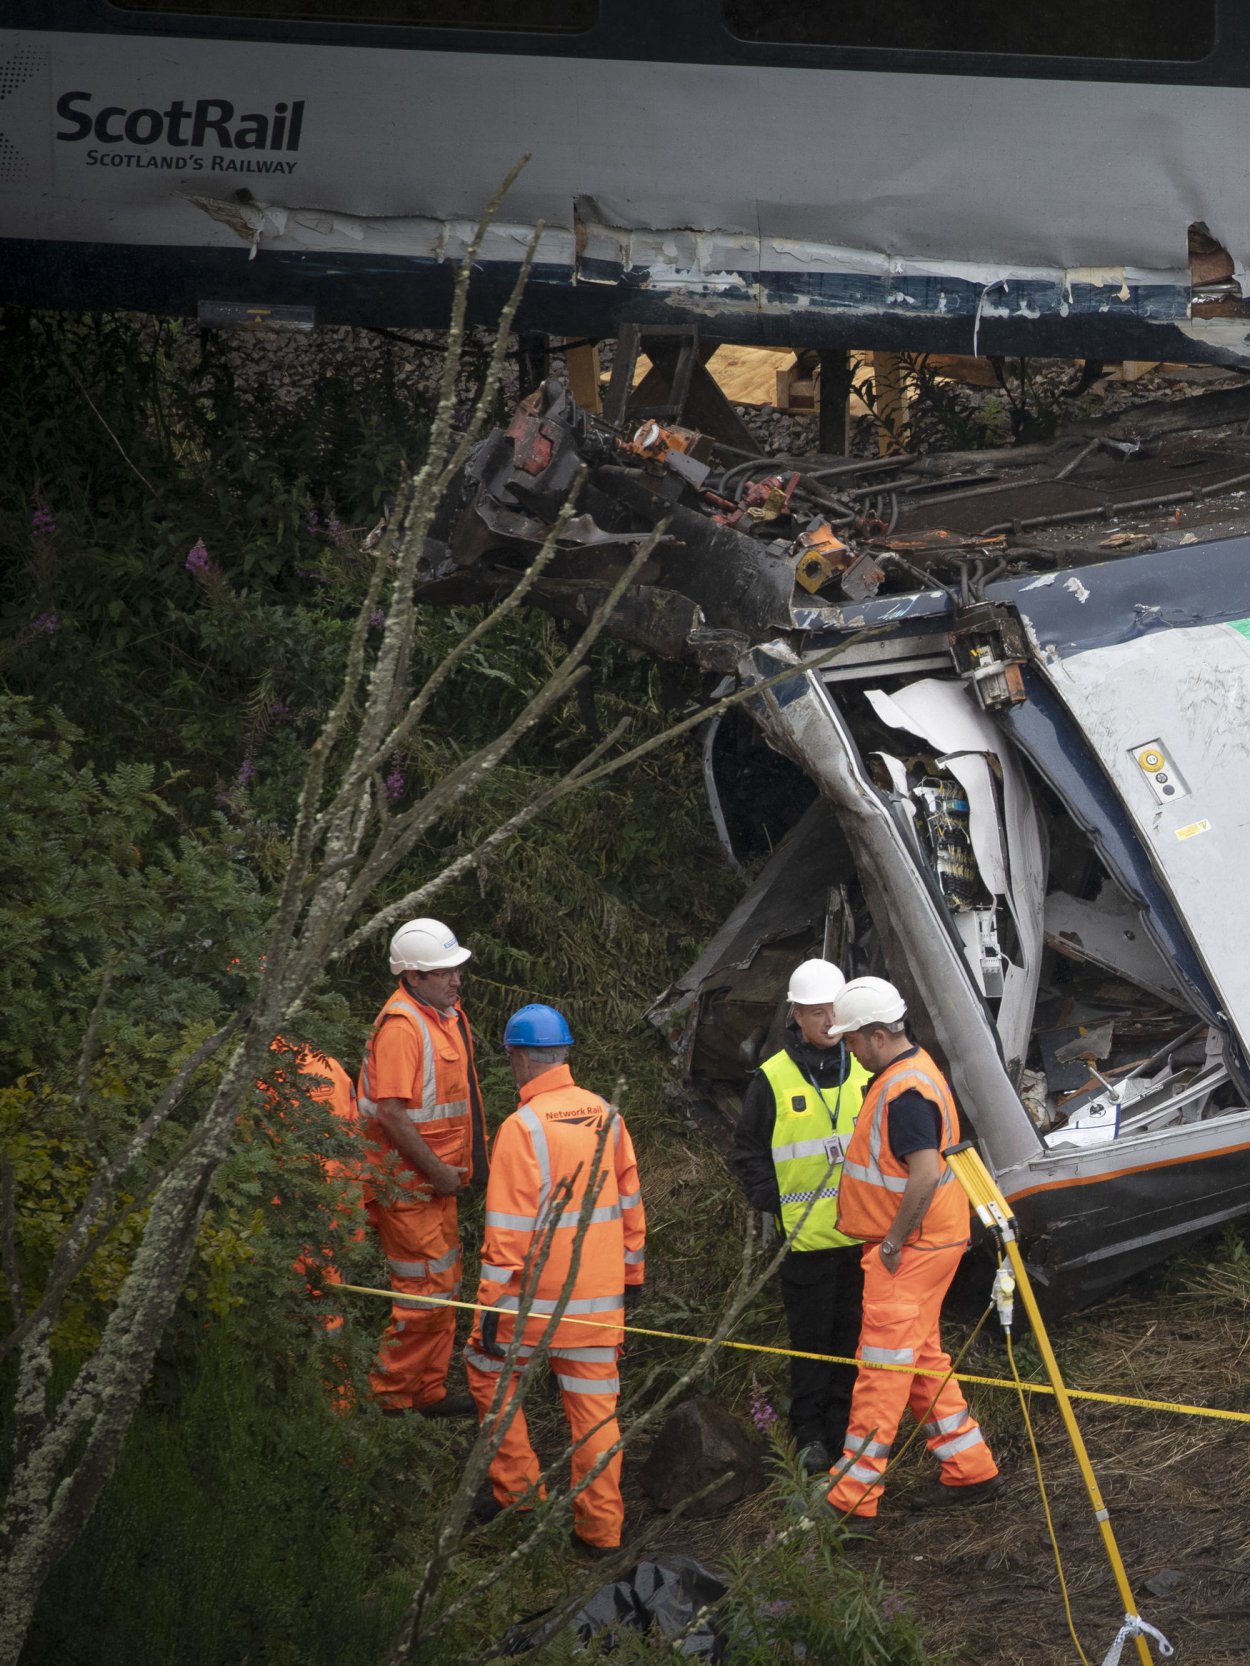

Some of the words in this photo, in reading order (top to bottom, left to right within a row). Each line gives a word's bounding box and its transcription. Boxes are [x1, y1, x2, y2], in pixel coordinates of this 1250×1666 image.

[56, 91, 305, 151] ScotRail
[545, 1108, 585, 1120] Network
[587, 1105, 602, 1115] Rail
